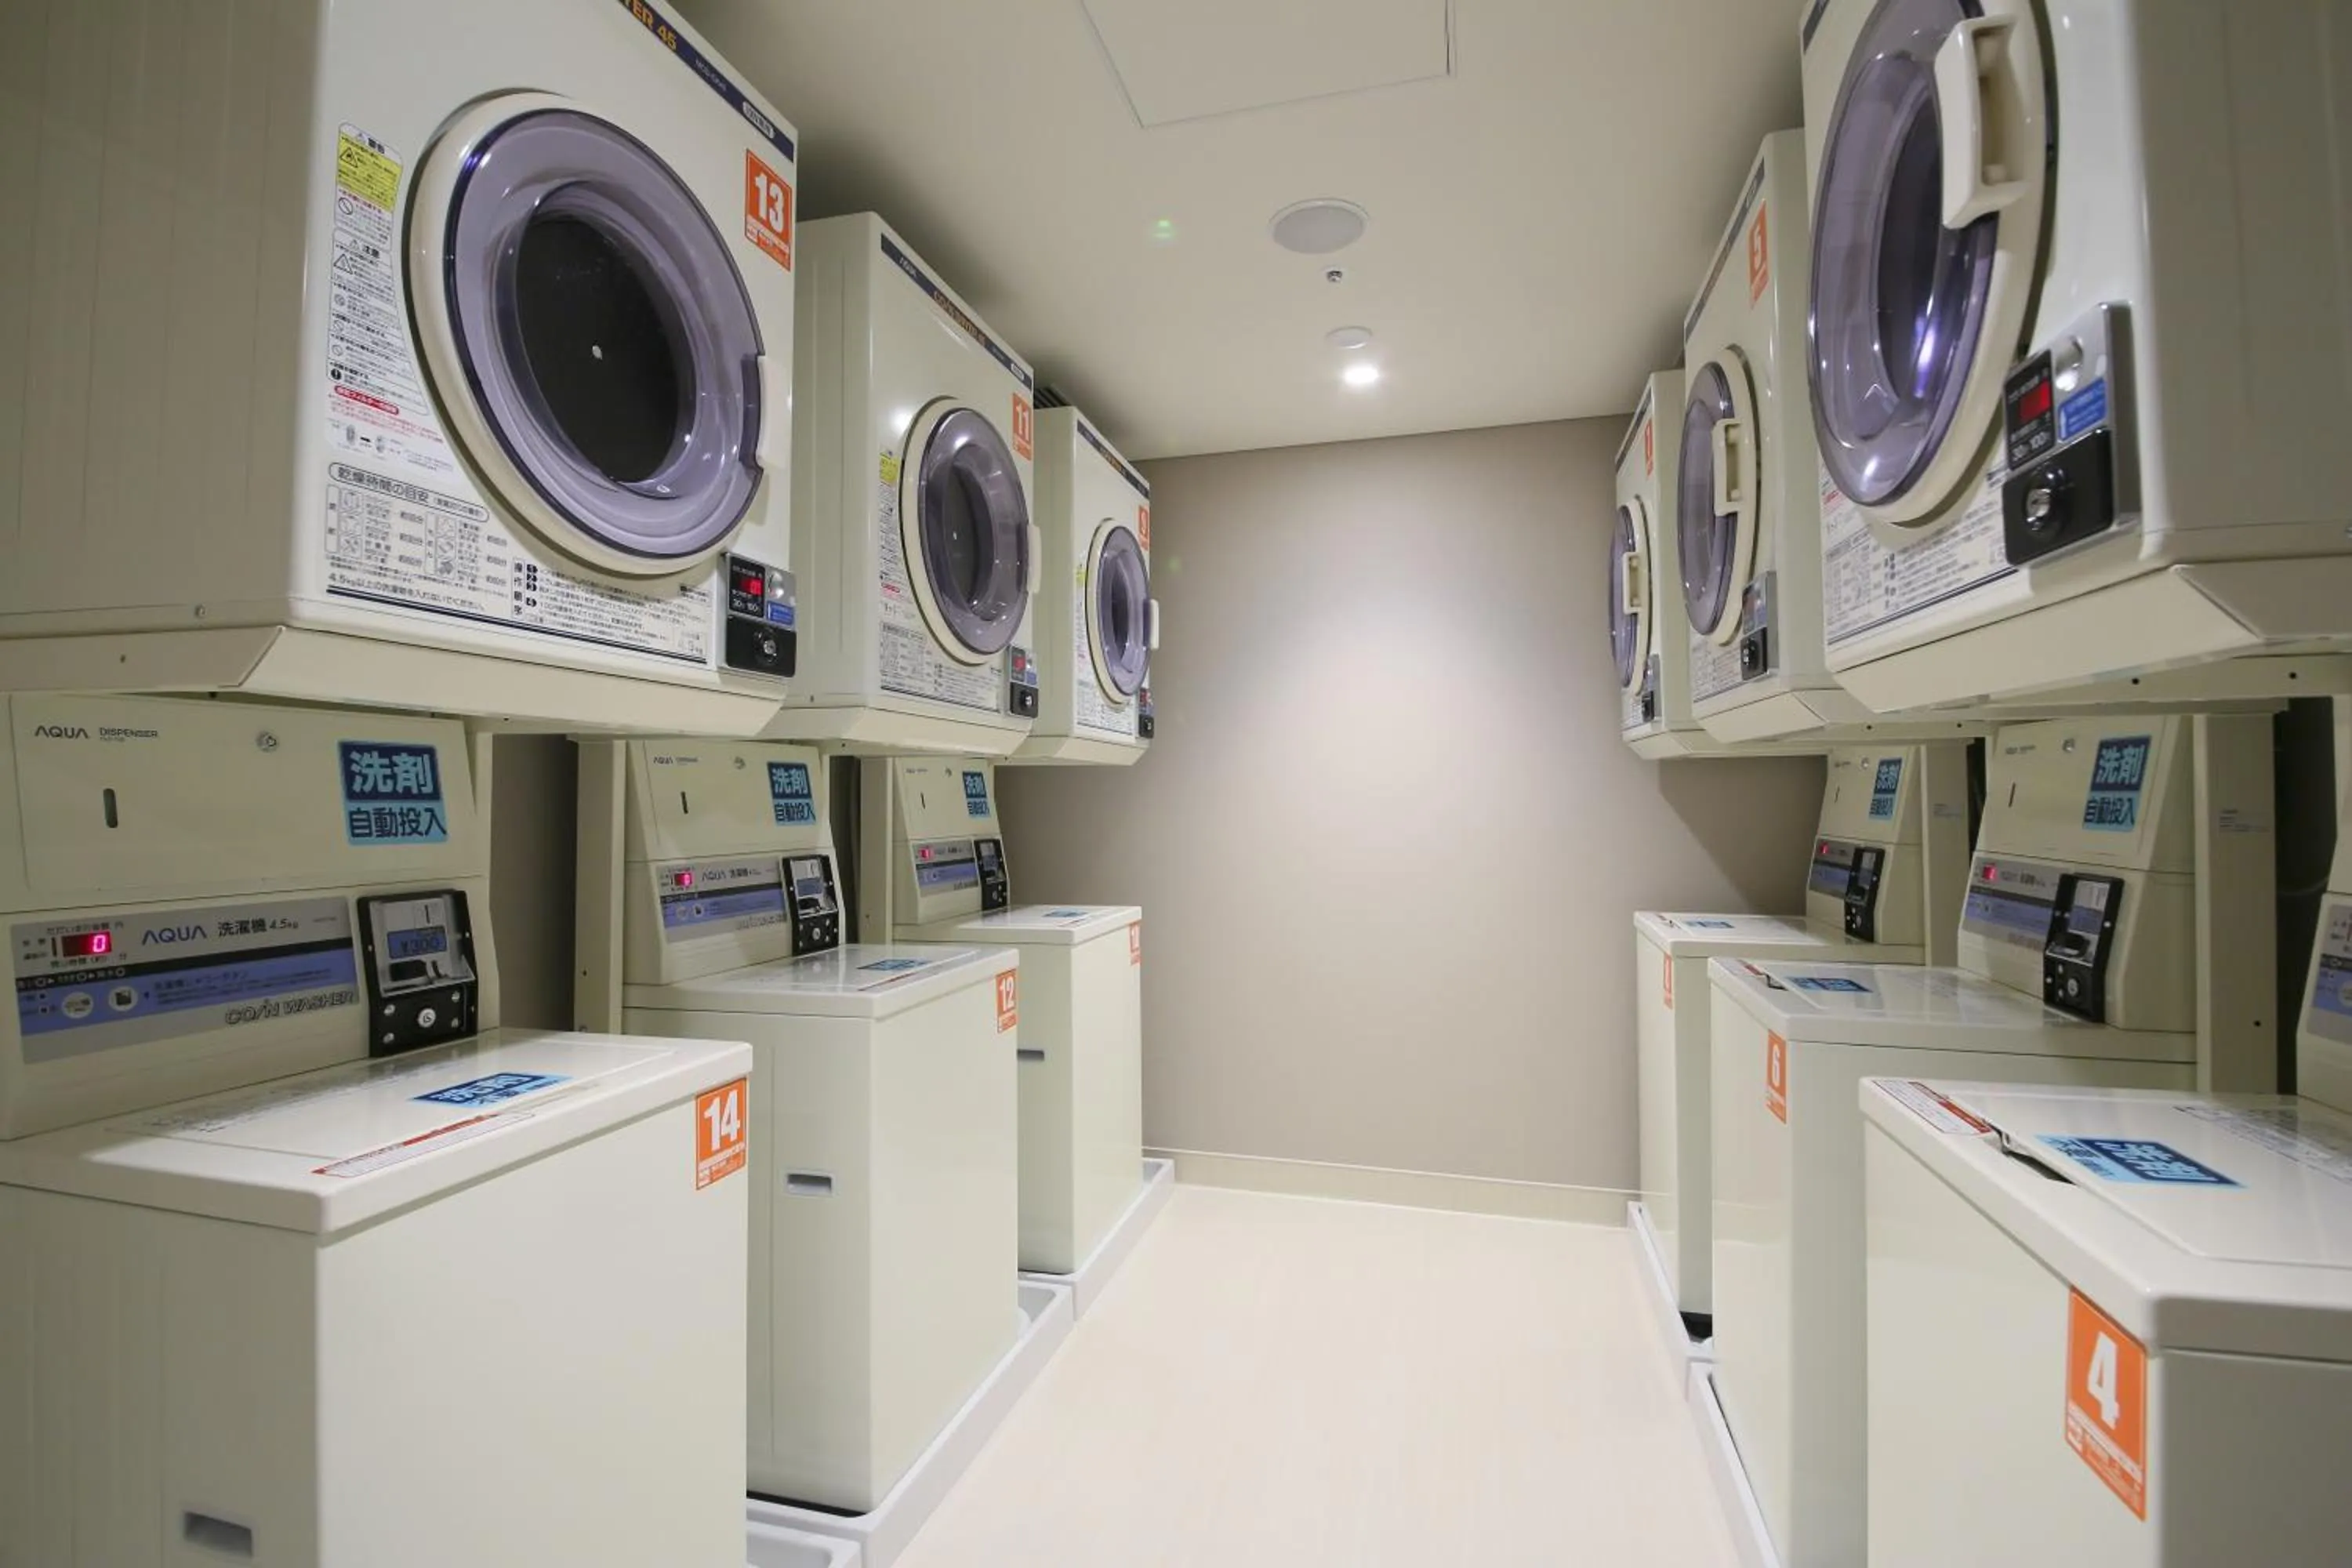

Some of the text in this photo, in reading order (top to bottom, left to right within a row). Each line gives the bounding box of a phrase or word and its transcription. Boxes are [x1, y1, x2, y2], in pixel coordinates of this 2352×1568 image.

[657, 24, 677, 50] 45
[755, 171, 785, 234] 13
[1015, 401, 1029, 443] 11
[34, 724, 158, 739] AQUA DISPENSER
[350, 750, 434, 795] 洗剤
[772, 767, 808, 795] 洗剤
[2095, 744, 2149, 785] 洗剤
[349, 808, 448, 838] 自動投入
[2083, 795, 2136, 826] 自動投入
[93, 934, 107, 953] 0
[142, 925, 207, 946] AQUA
[218, 918, 268, 938] 洗濯機
[224, 998, 280, 1025] COIN
[284, 990, 355, 1015] WASHER
[1000, 975, 1015, 1012] 12
[1772, 1043, 1781, 1087] 6
[704, 1089, 741, 1152] 14
[2086, 1330, 2121, 1429] 4
